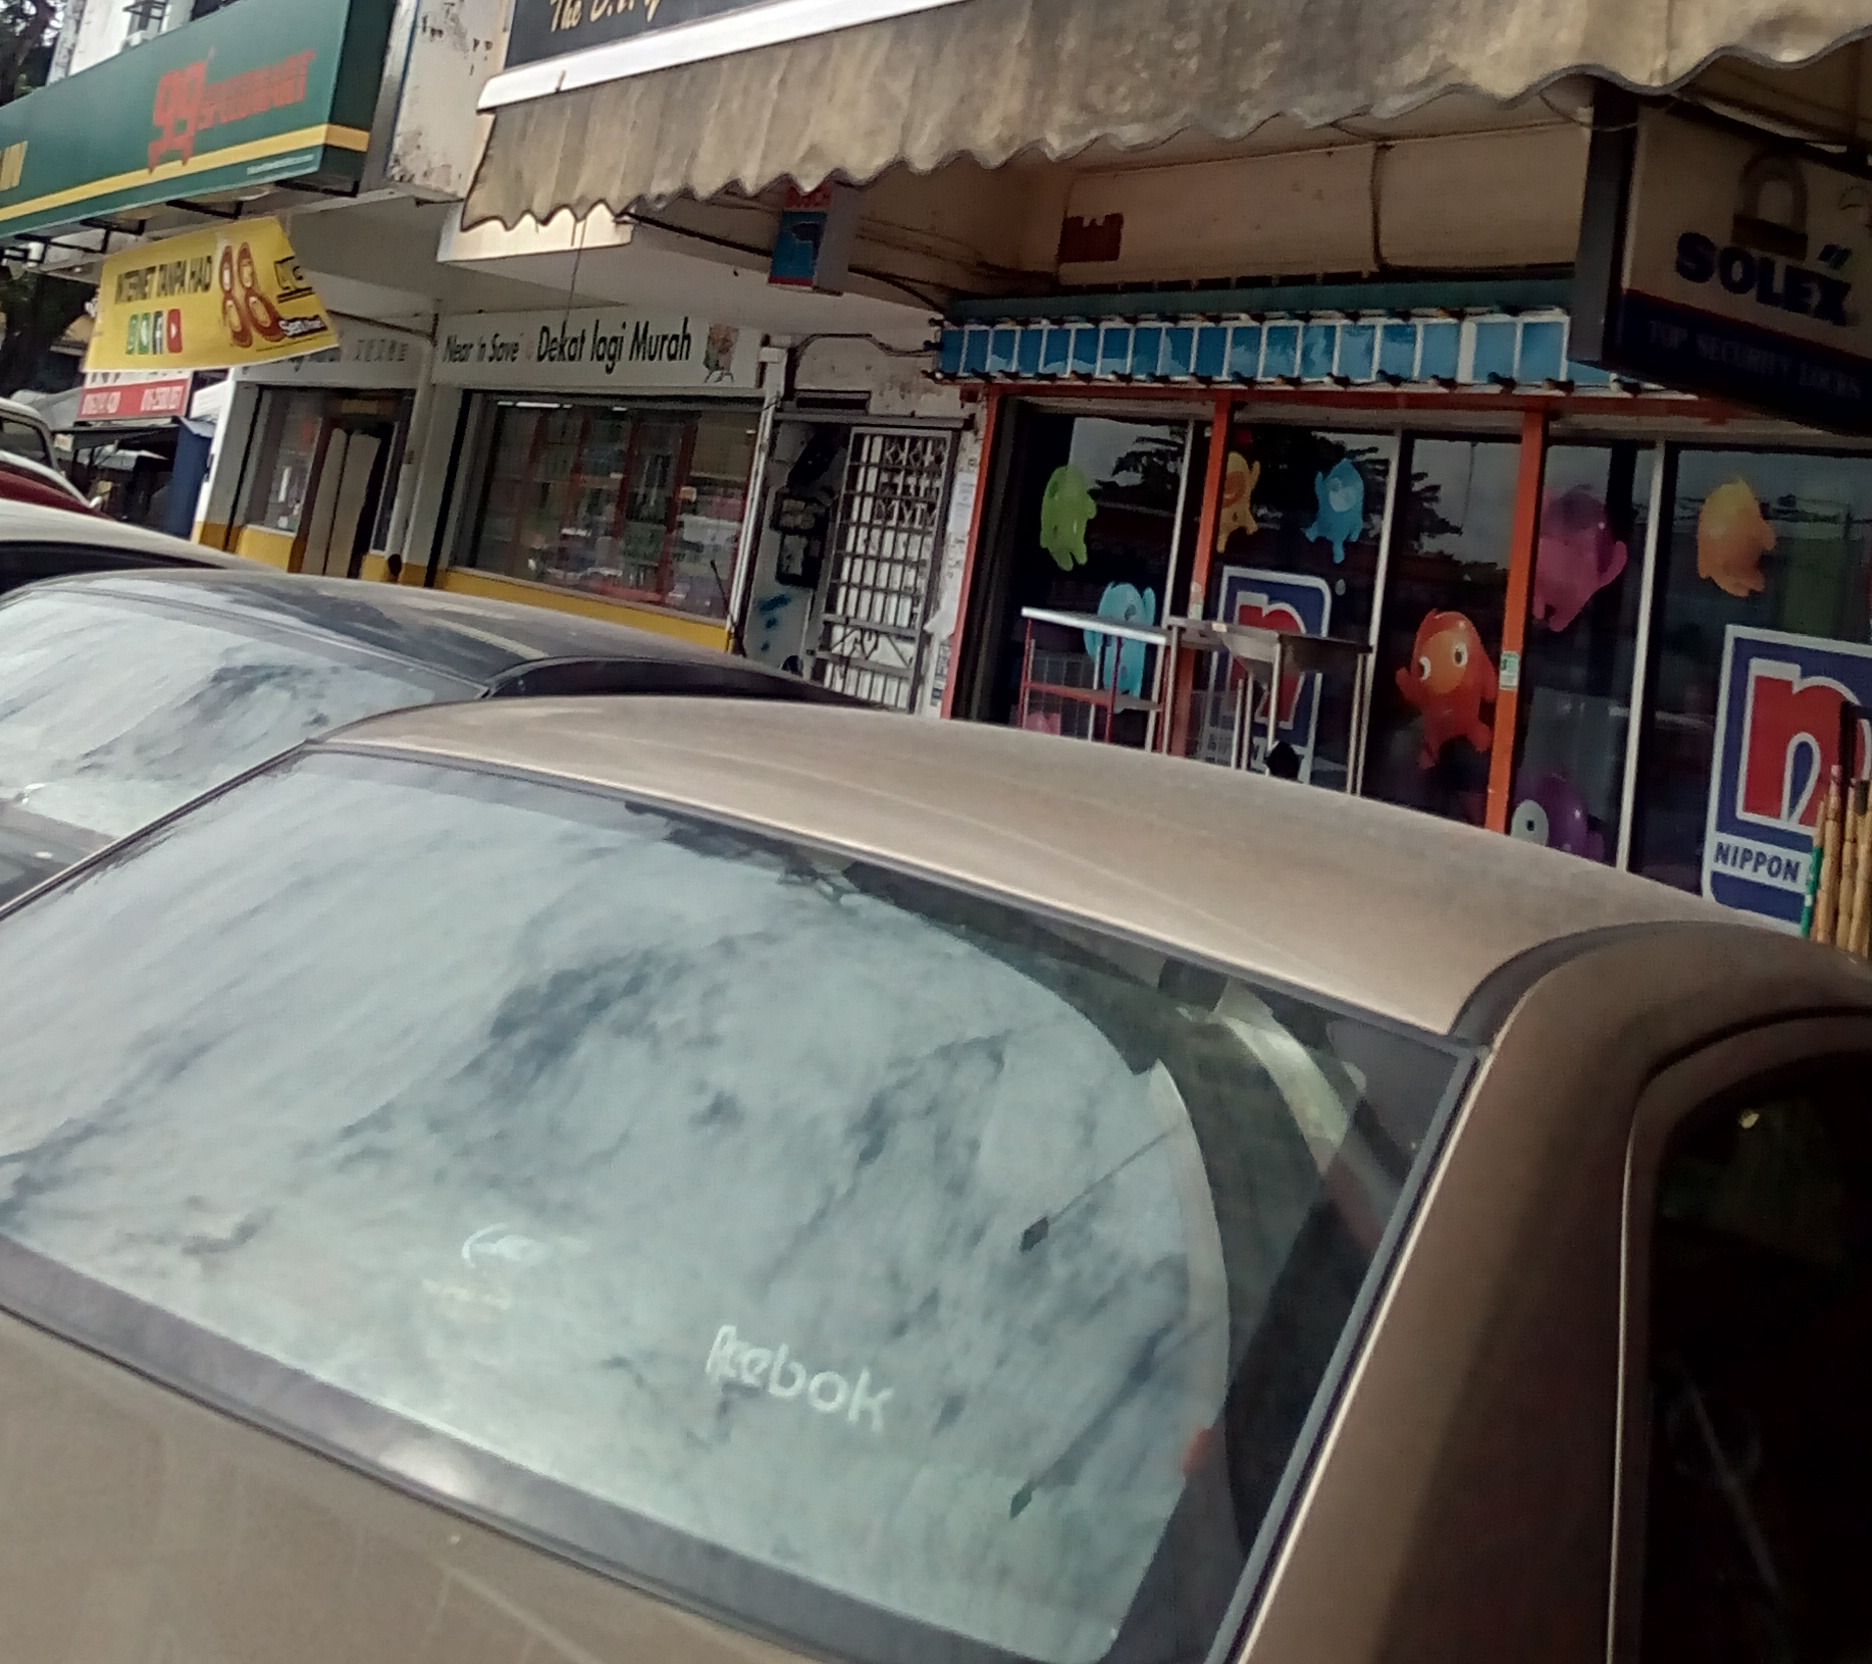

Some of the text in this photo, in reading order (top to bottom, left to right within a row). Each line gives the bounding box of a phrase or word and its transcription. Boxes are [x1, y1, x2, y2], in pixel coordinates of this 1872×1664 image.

[1676, 231, 1852, 327] SOLEX
[536, 321, 586, 363] Dekat
[589, 319, 627, 375] lagi
[628, 316, 692, 363] Murah
[1714, 841, 1802, 883] NIPPON
